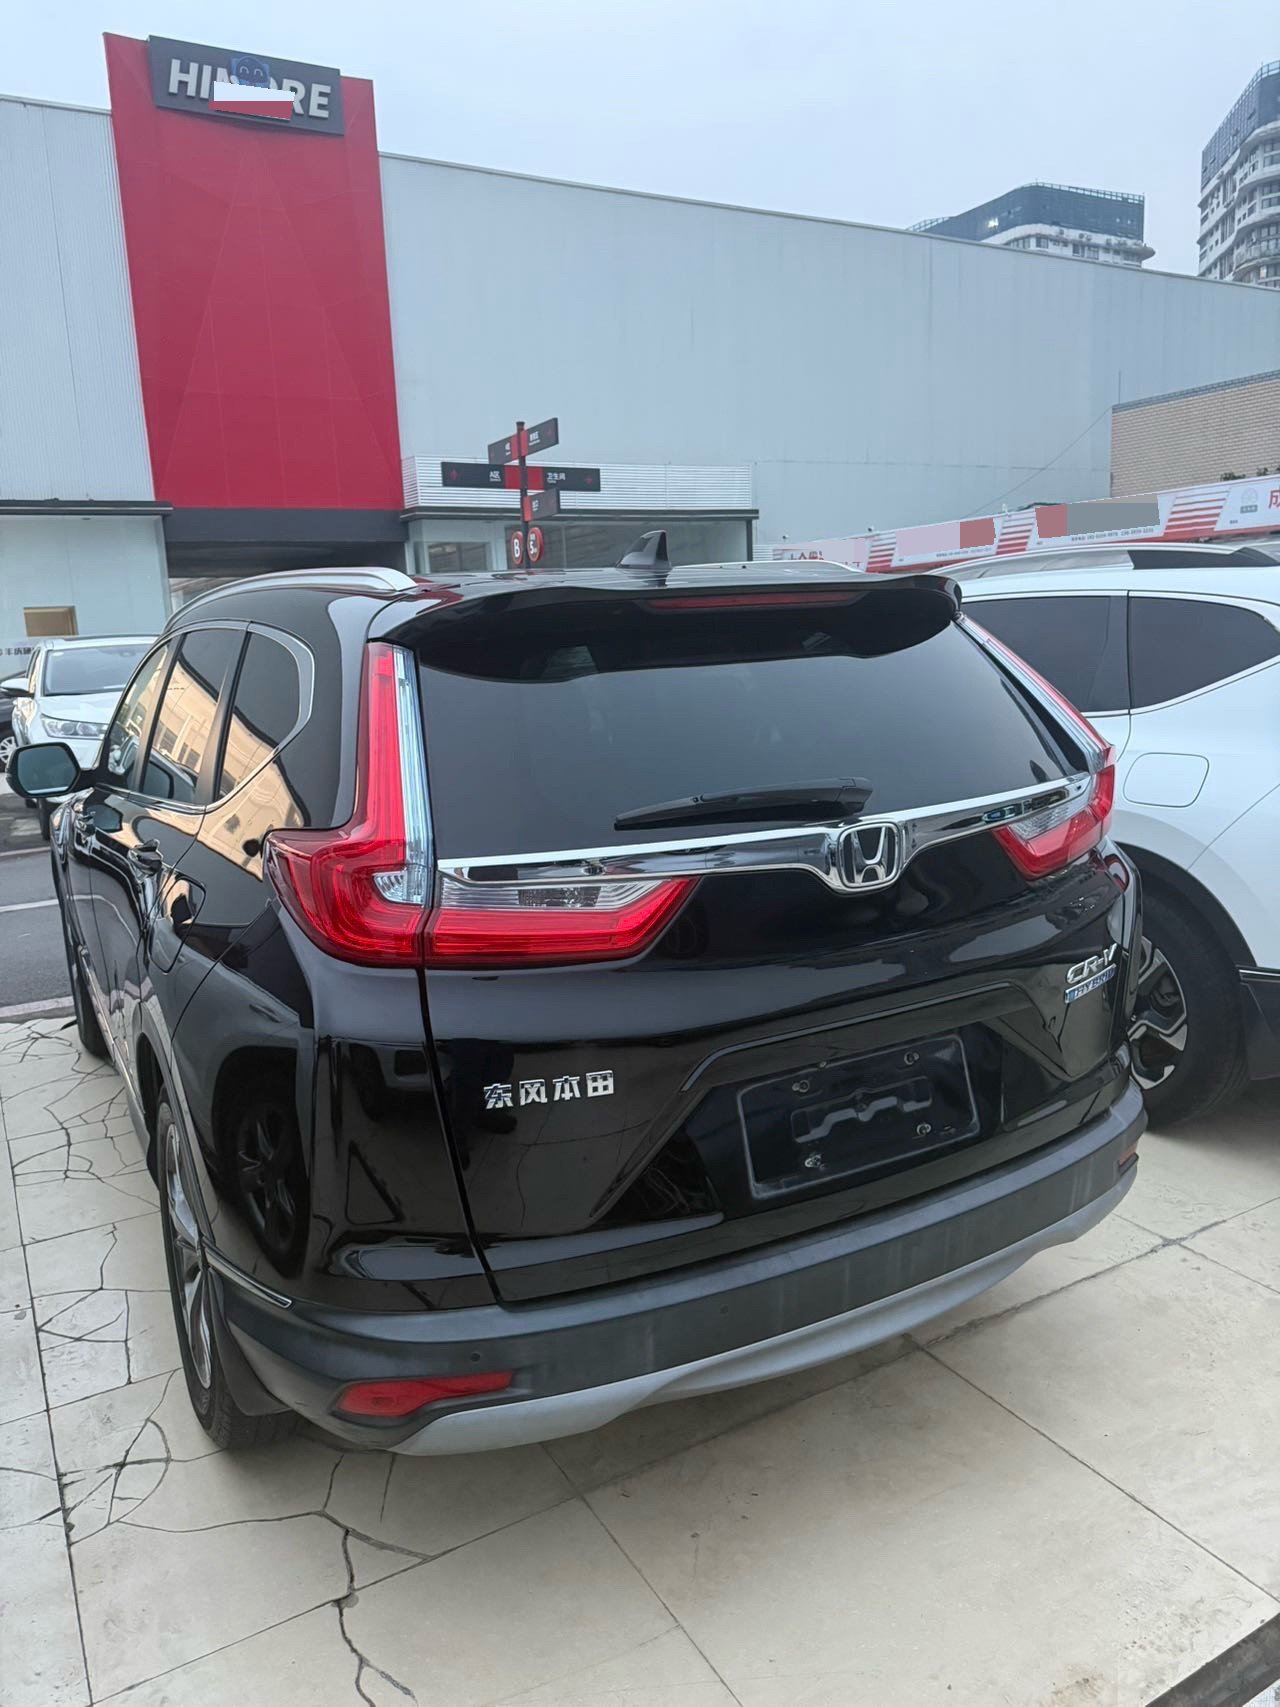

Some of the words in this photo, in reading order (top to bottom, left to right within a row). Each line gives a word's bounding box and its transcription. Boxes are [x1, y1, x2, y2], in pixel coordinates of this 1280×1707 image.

[167, 58, 331, 119] HIRE
[1066, 943, 1117, 984] CR-V
[1072, 967, 1116, 1000] HYBRID
[483, 1069, 614, 1109] 东风本田
